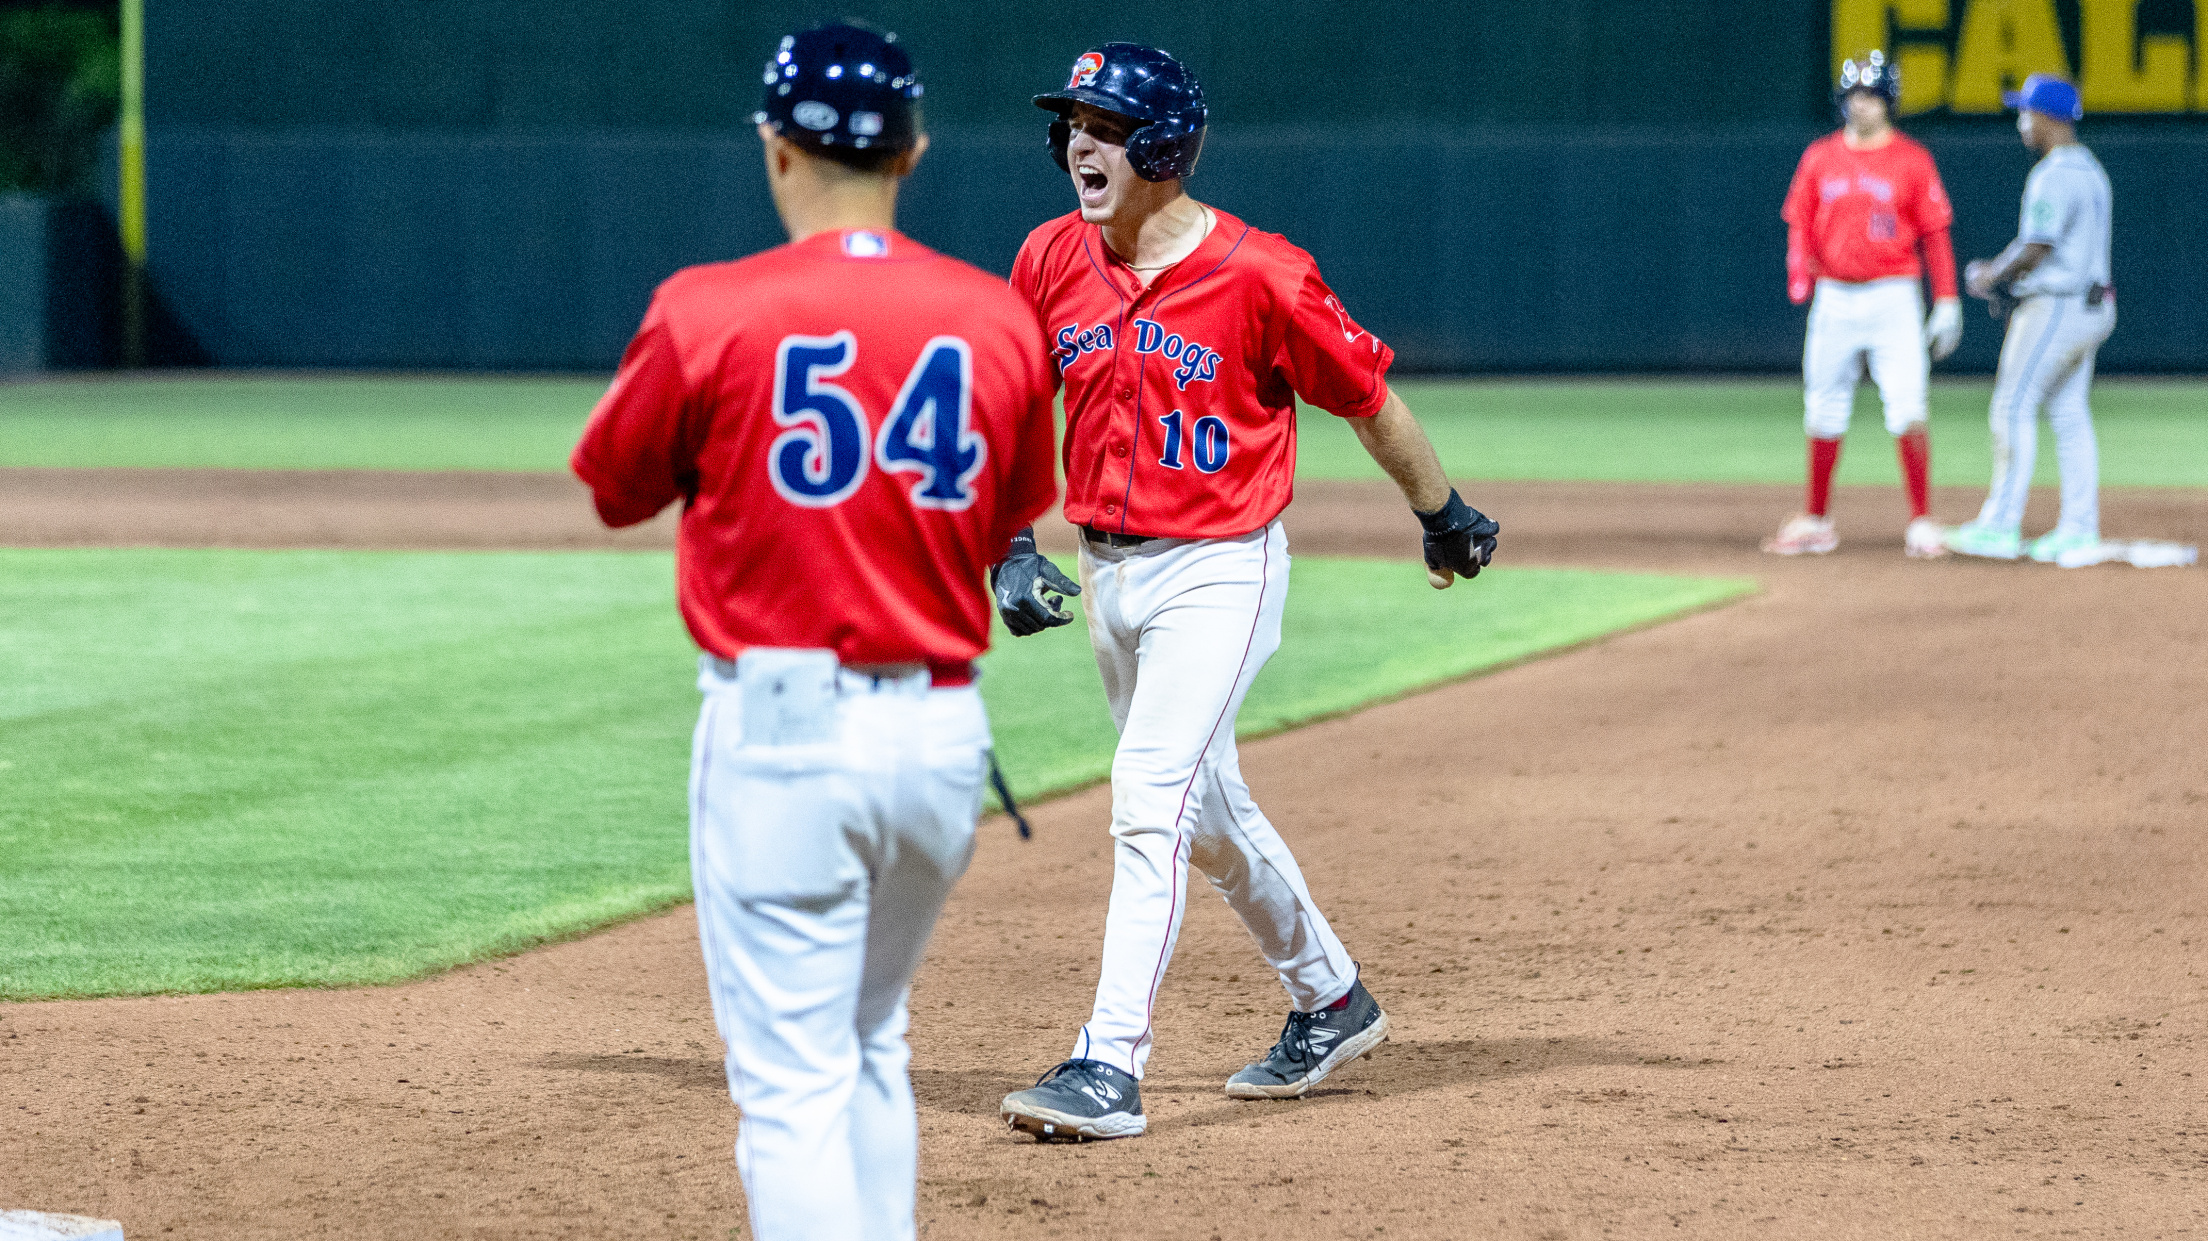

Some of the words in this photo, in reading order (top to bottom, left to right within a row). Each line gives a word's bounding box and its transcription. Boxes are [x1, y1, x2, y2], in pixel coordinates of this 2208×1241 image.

[1832, 0, 2208, 115] CAL
[1050, 322, 1113, 376] Sea
[1134, 318, 1223, 391] Dogs
[767, 329, 988, 512] 54
[1159, 409, 1230, 474] 10
